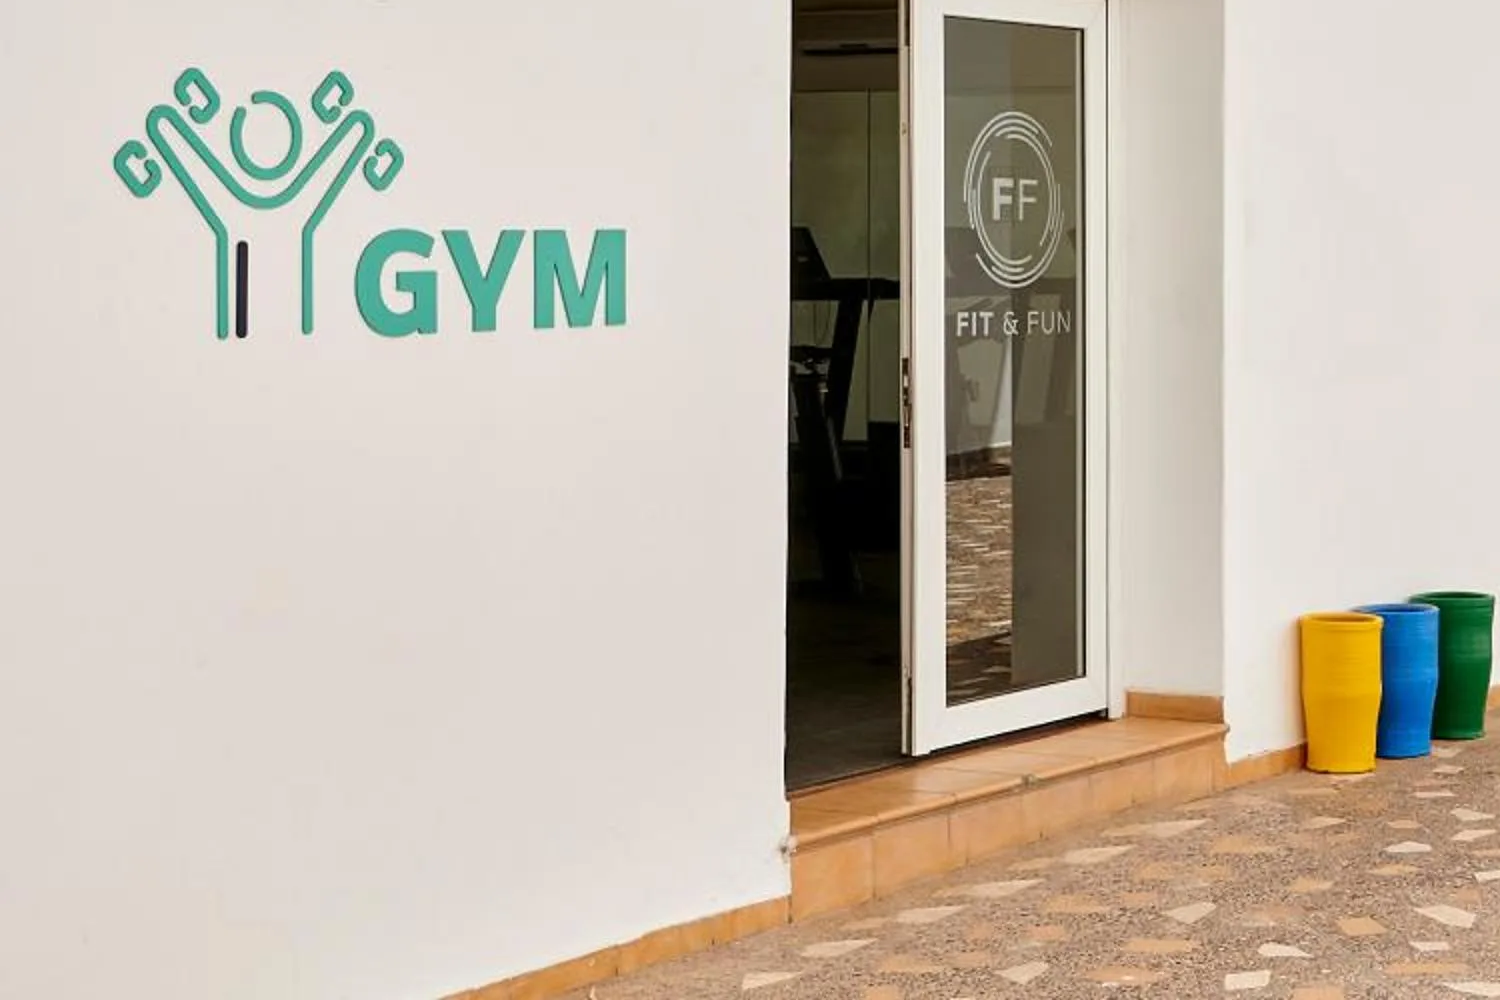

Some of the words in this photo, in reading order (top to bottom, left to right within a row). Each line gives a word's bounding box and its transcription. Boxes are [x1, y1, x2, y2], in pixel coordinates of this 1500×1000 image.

[992, 177, 1038, 221] FF
[354, 228, 627, 337] GYM
[957, 312, 995, 337] FIT
[1003, 311, 1019, 335] &
[1027, 310, 1072, 334] FUN
